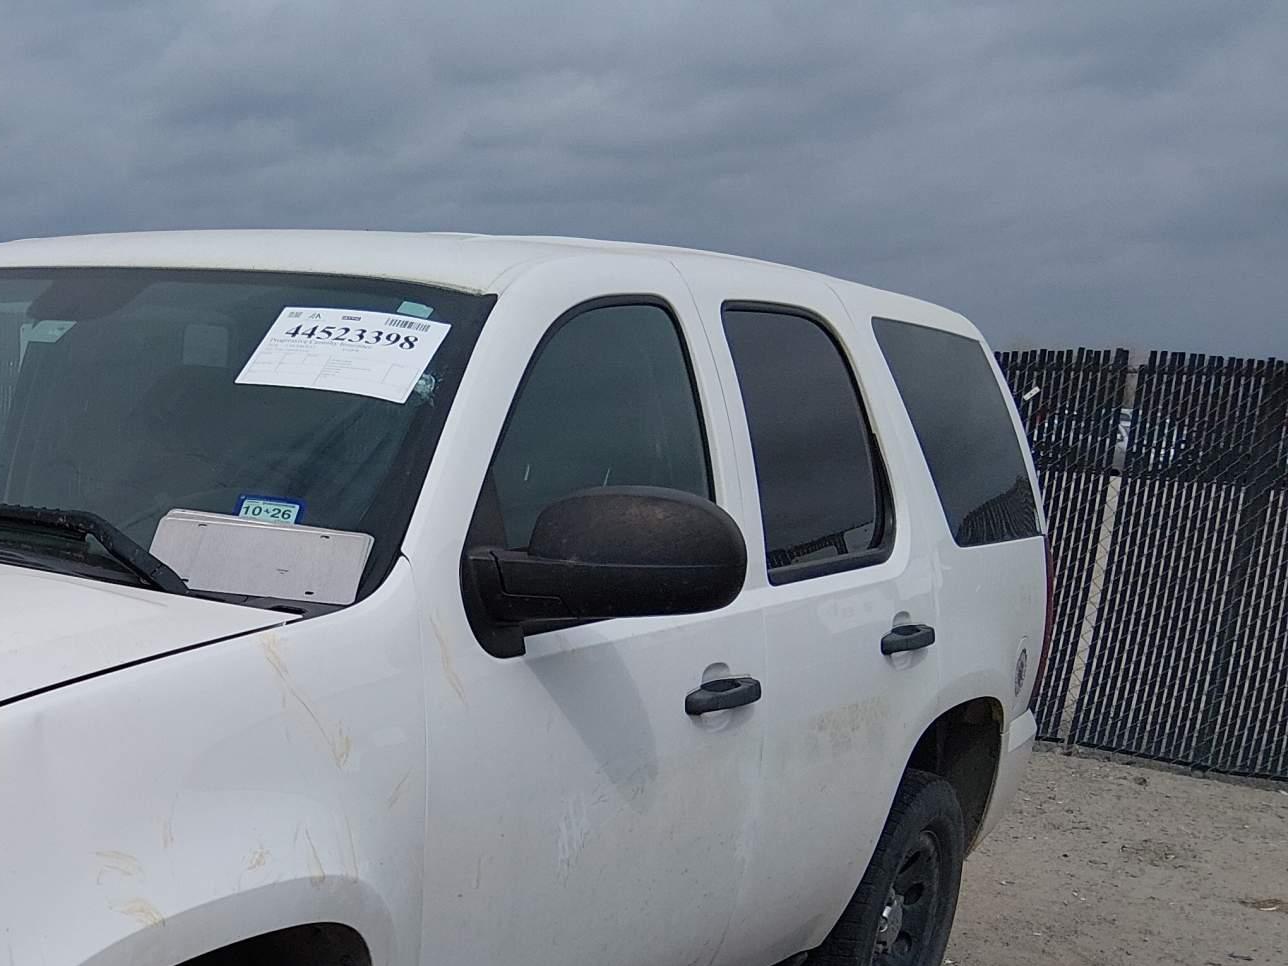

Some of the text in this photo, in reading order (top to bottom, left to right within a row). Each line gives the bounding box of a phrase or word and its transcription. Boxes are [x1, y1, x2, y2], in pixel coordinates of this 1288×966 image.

[285, 324, 418, 351] 44523398
[243, 505, 292, 520] 10 26
